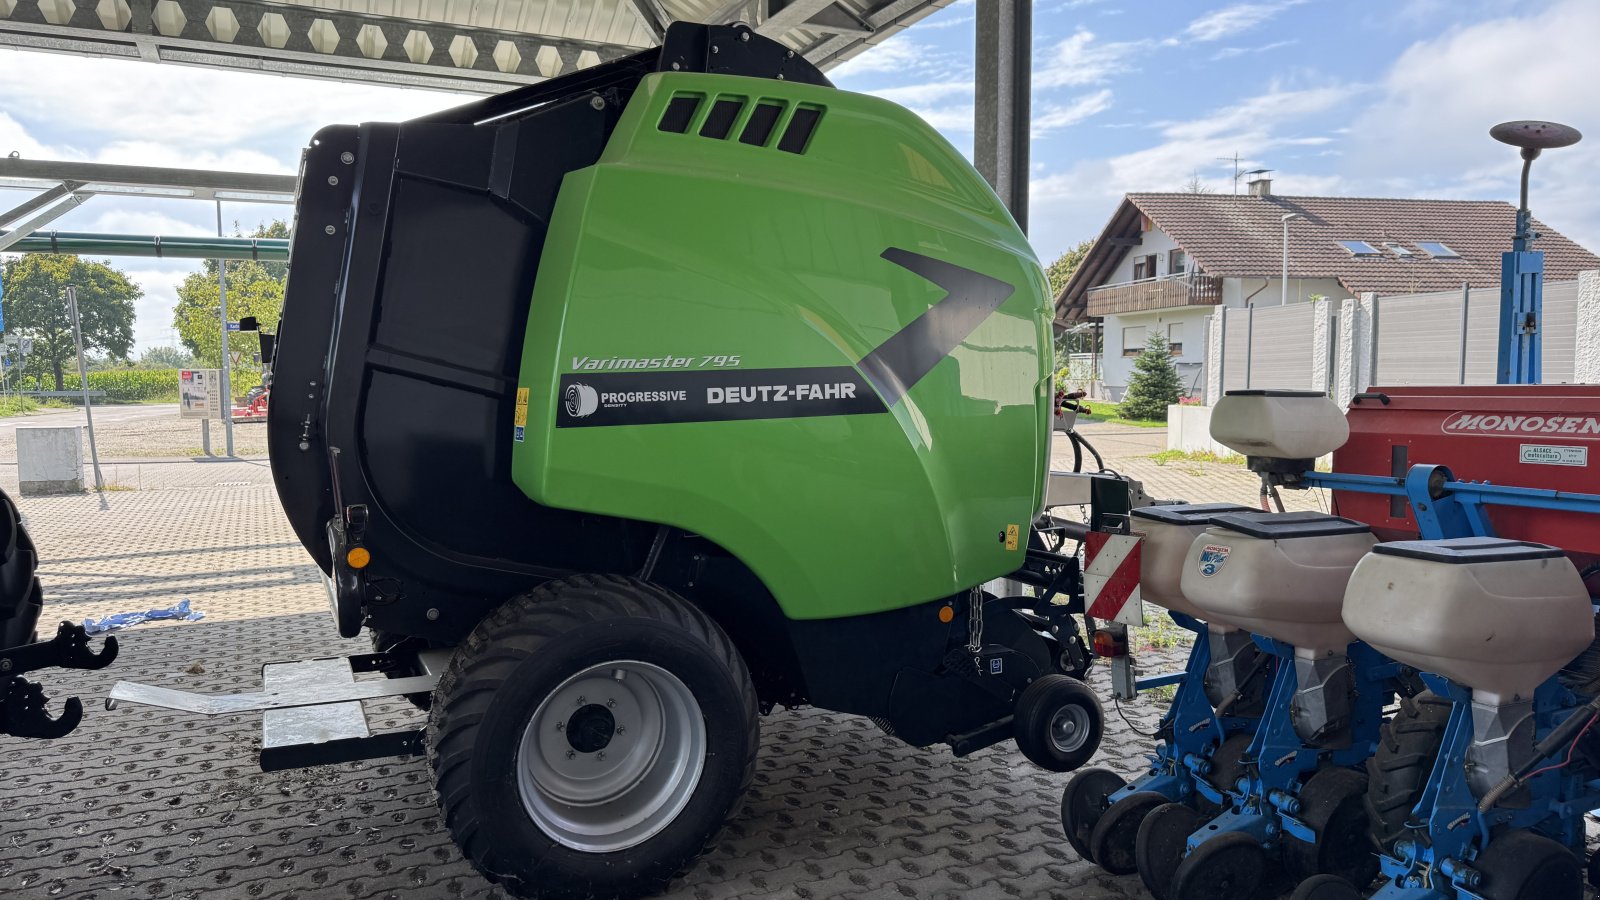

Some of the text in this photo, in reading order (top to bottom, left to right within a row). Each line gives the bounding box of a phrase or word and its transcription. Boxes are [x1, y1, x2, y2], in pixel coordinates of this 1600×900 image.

[571, 355, 742, 370] Varimaster 795
[601, 390, 687, 403] PROGRESSIVE
[706, 382, 857, 404] DEUTZ-FAHR
[1202, 563, 1216, 575] 3
